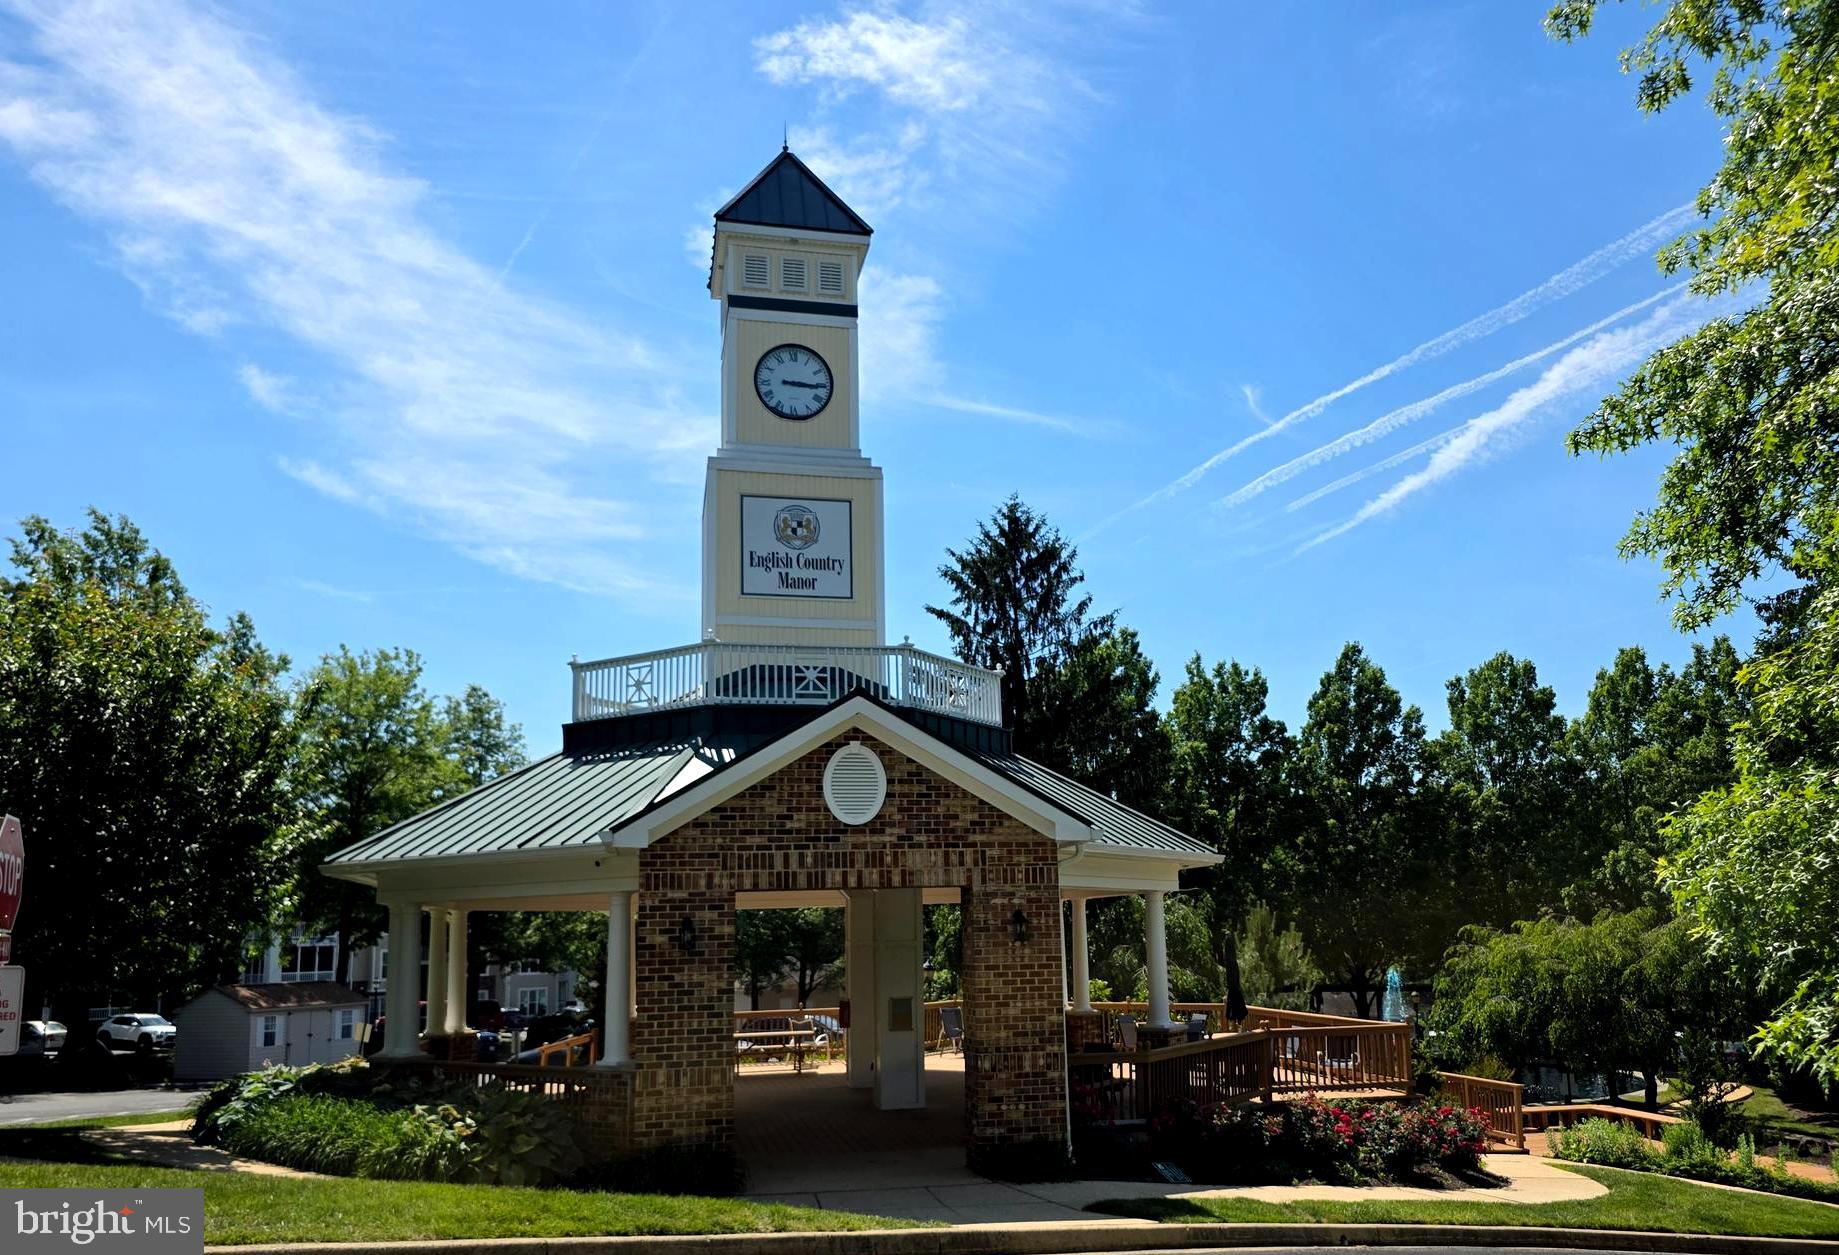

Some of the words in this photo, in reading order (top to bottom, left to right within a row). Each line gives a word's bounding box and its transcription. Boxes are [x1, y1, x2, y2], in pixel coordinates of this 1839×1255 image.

[749, 551, 793, 572] English
[796, 552, 845, 575] Country
[778, 571, 818, 590] Manor
